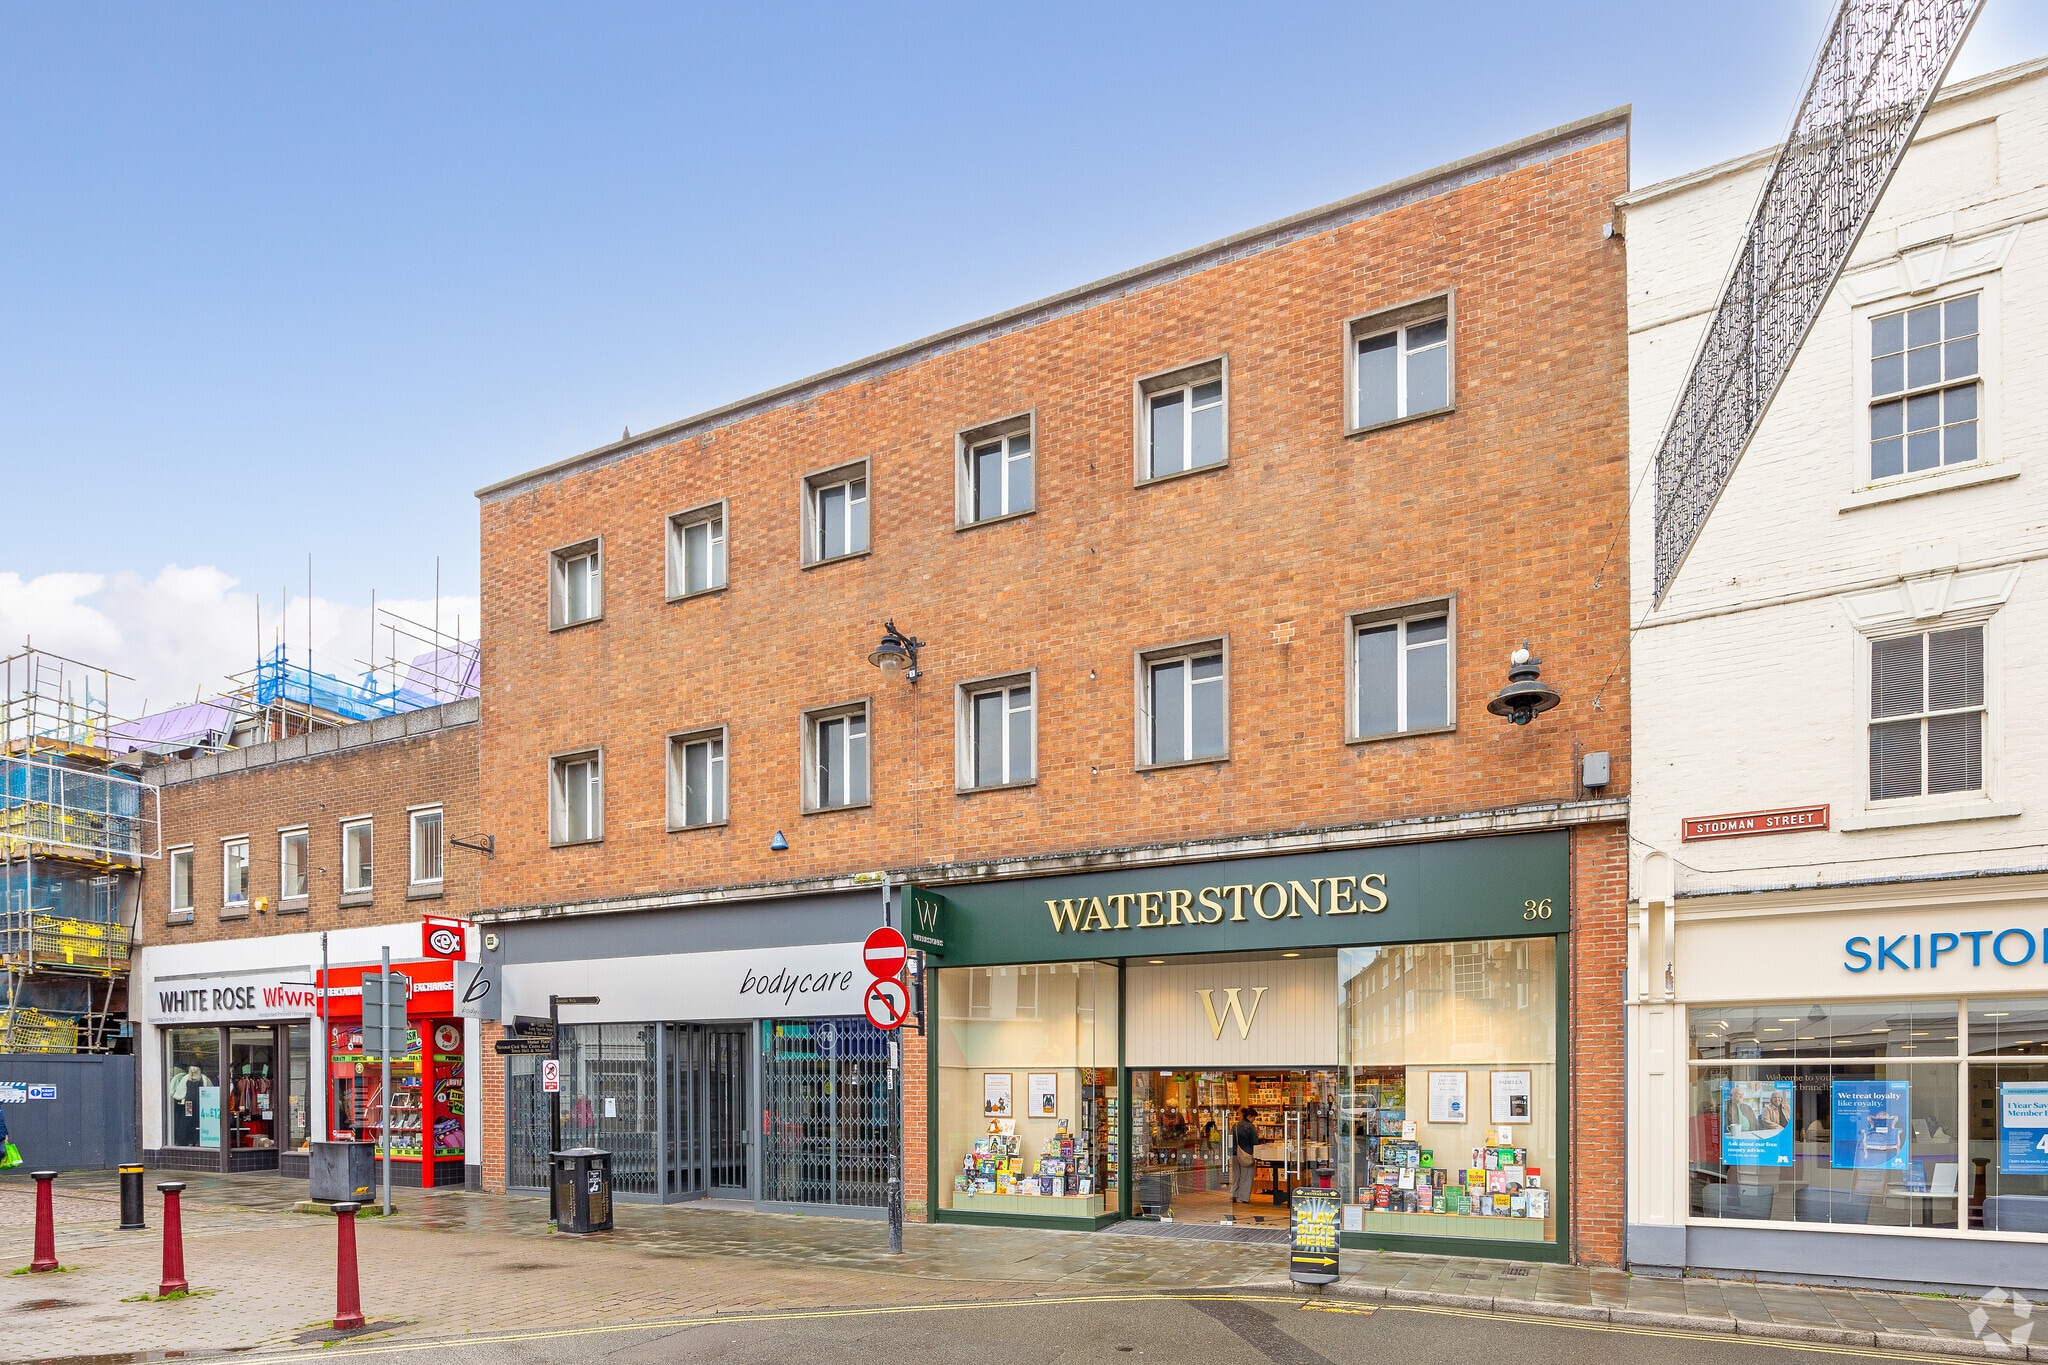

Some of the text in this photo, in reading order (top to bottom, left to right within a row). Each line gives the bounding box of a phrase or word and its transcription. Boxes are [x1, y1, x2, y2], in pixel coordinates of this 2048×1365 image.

[1696, 814, 1814, 832] STODMAN STREET
[1044, 873, 1389, 933] WATERSTONES
[1523, 898, 1552, 920] 36
[915, 897, 938, 933] W
[1844, 928, 2048, 973] SKIPTO
[414, 981, 454, 993] EXCHANGE
[462, 965, 491, 1004] b
[740, 967, 853, 1006] bodycare
[159, 989, 208, 1014] WHITE
[212, 986, 256, 1011] ROSE
[284, 990, 315, 1007] WR
[1195, 987, 1269, 1041] W
[201, 1108, 206, 1119] 4
[1297, 1210, 1336, 1224] PLAY
[1297, 1224, 1336, 1236] SLOTS
[1296, 1236, 1336, 1248] HERE
